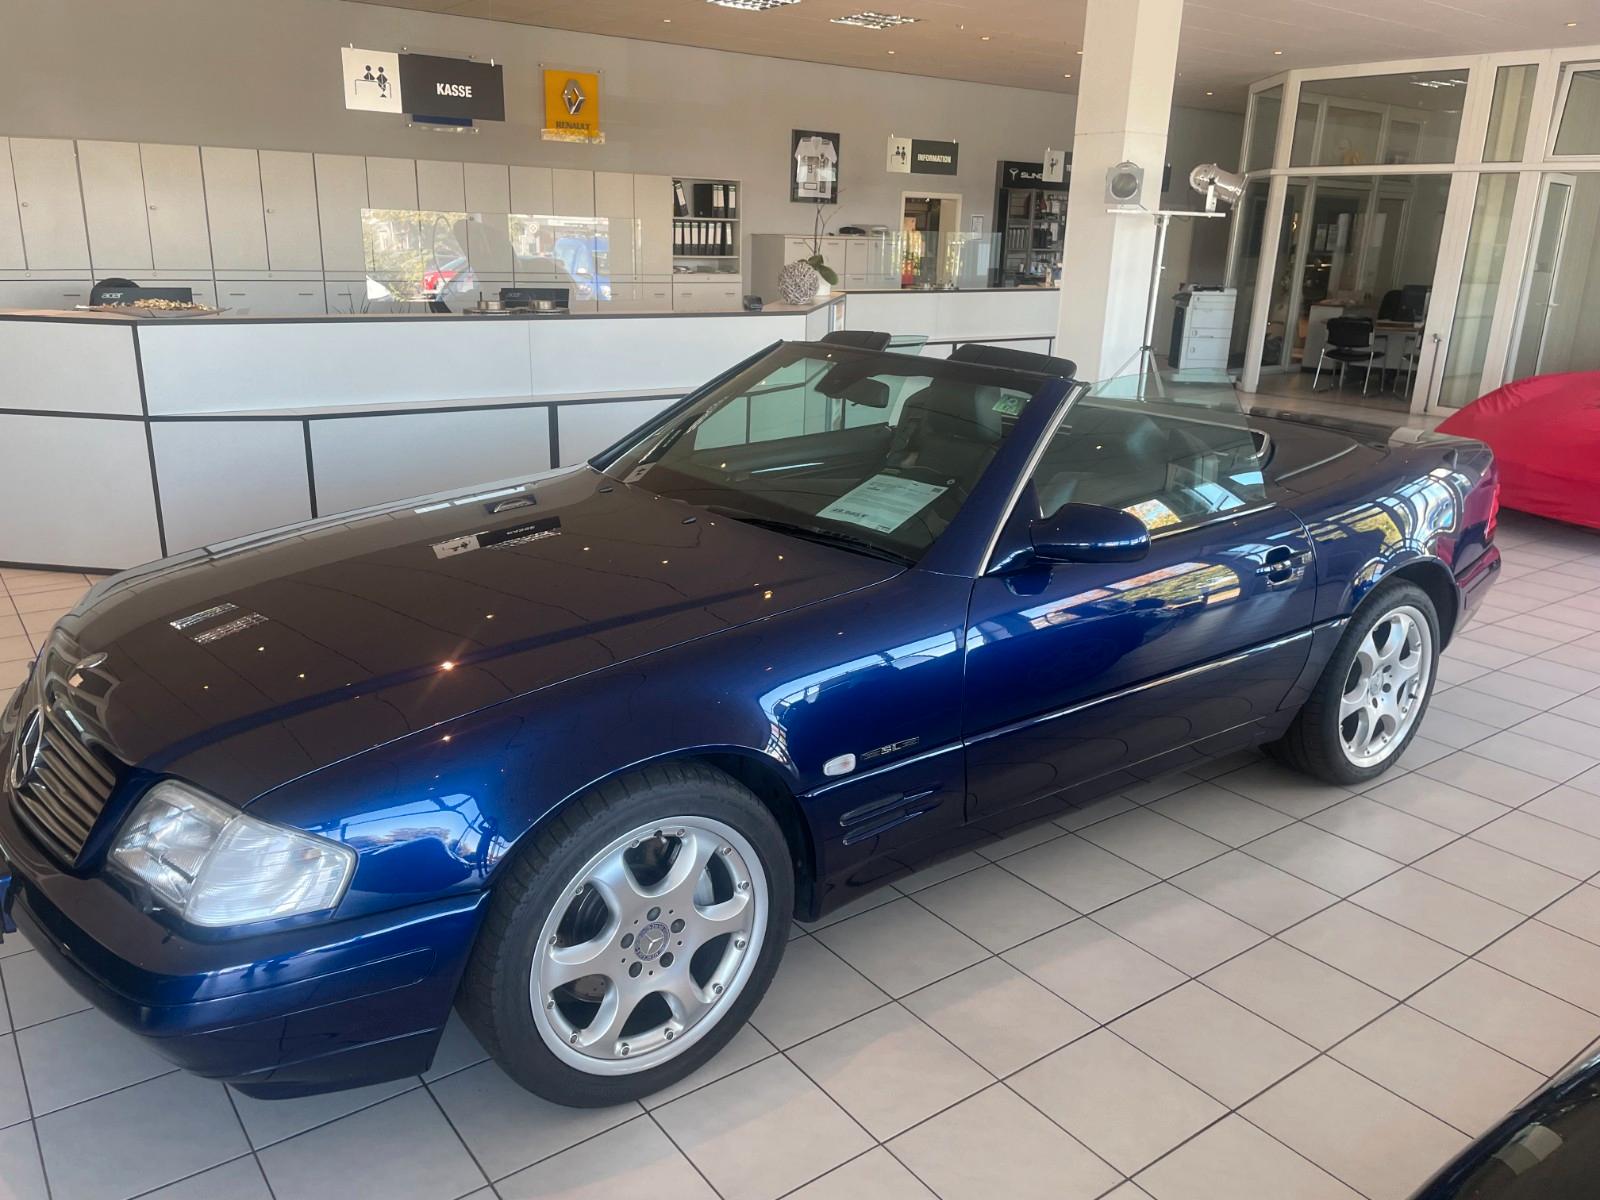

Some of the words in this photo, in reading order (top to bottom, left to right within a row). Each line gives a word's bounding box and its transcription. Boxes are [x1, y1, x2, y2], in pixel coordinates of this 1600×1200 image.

[436, 82, 473, 98] KASSE
[555, 120, 591, 130] RENAULT
[917, 153, 951, 163] INFORMATION
